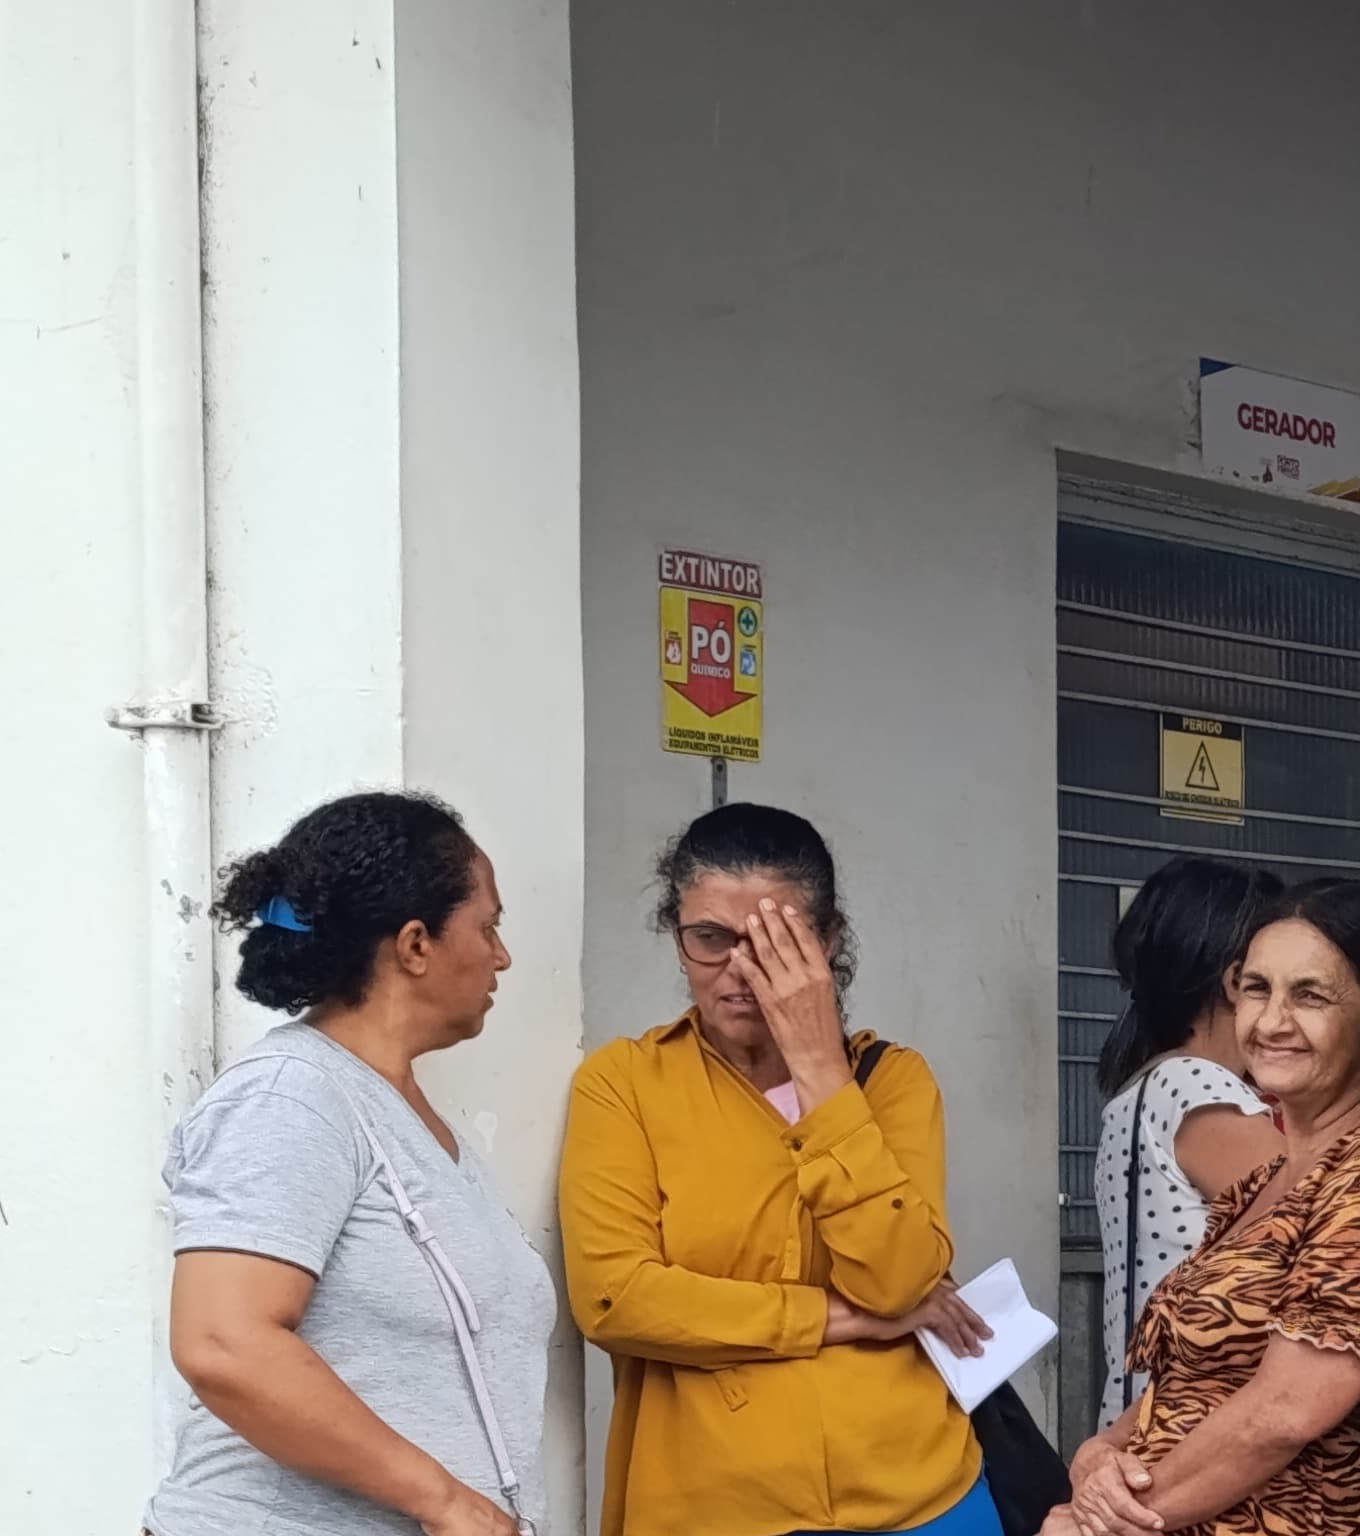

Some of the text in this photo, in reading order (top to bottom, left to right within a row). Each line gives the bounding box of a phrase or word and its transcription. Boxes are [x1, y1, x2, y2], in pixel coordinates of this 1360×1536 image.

[1237, 403, 1336, 448] GERADOR
[661, 552, 760, 595] EXTINTOR
[690, 621, 731, 664] PÓ
[669, 726, 706, 740] LÍQUIDOS
[1183, 717, 1222, 735] PERIGO
